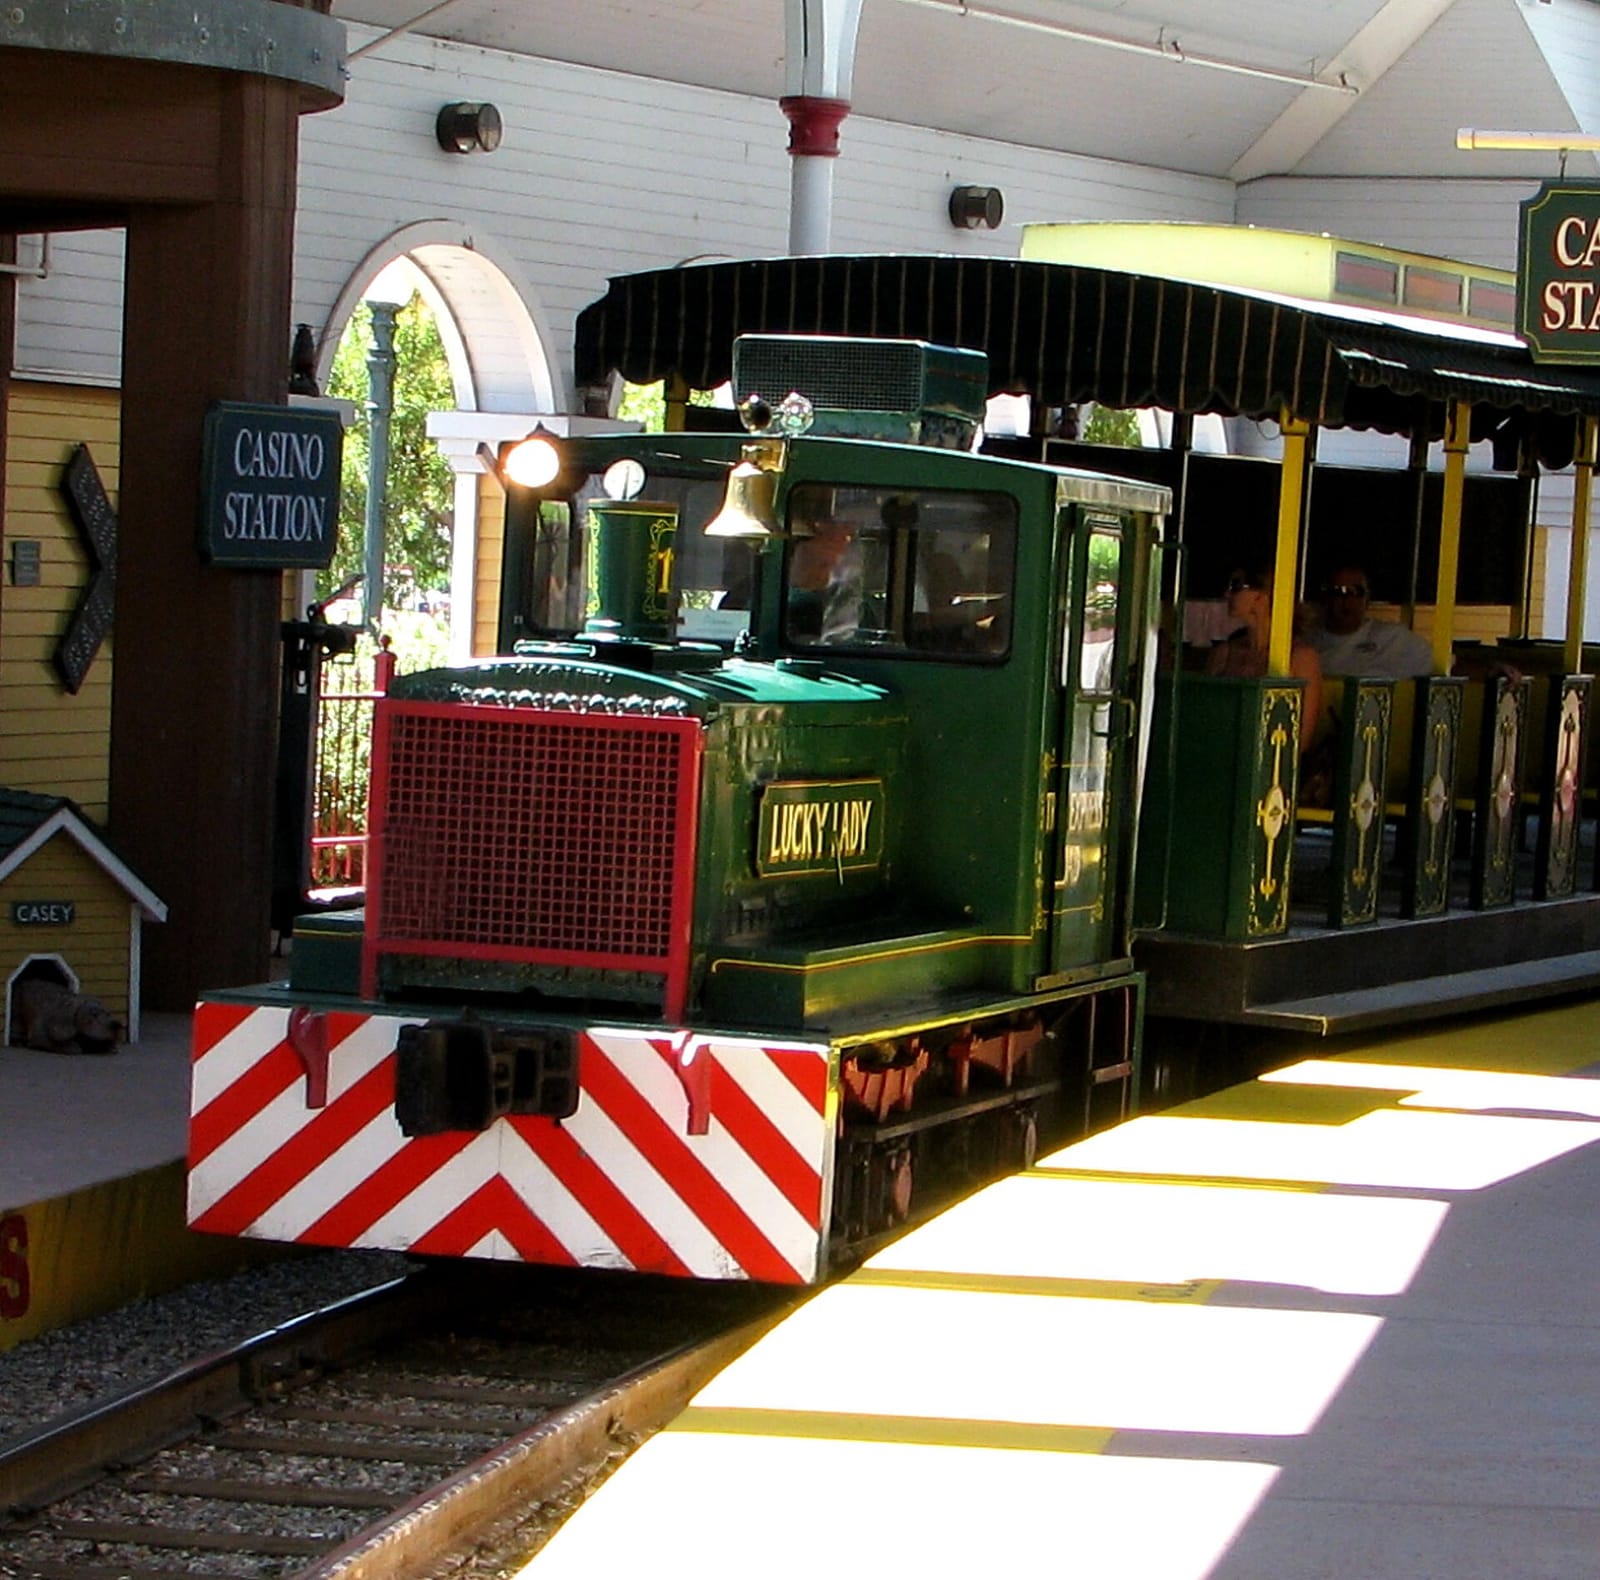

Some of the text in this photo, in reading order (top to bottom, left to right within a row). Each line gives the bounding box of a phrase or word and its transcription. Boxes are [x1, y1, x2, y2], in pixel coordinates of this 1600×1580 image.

[1542, 280, 1600, 331] ST
[234, 428, 324, 481] CASINO
[223, 492, 326, 544] STATION
[657, 547, 674, 595] 1
[769, 800, 873, 862] LUCKY LADY
[16, 905, 73, 922] CASEY
